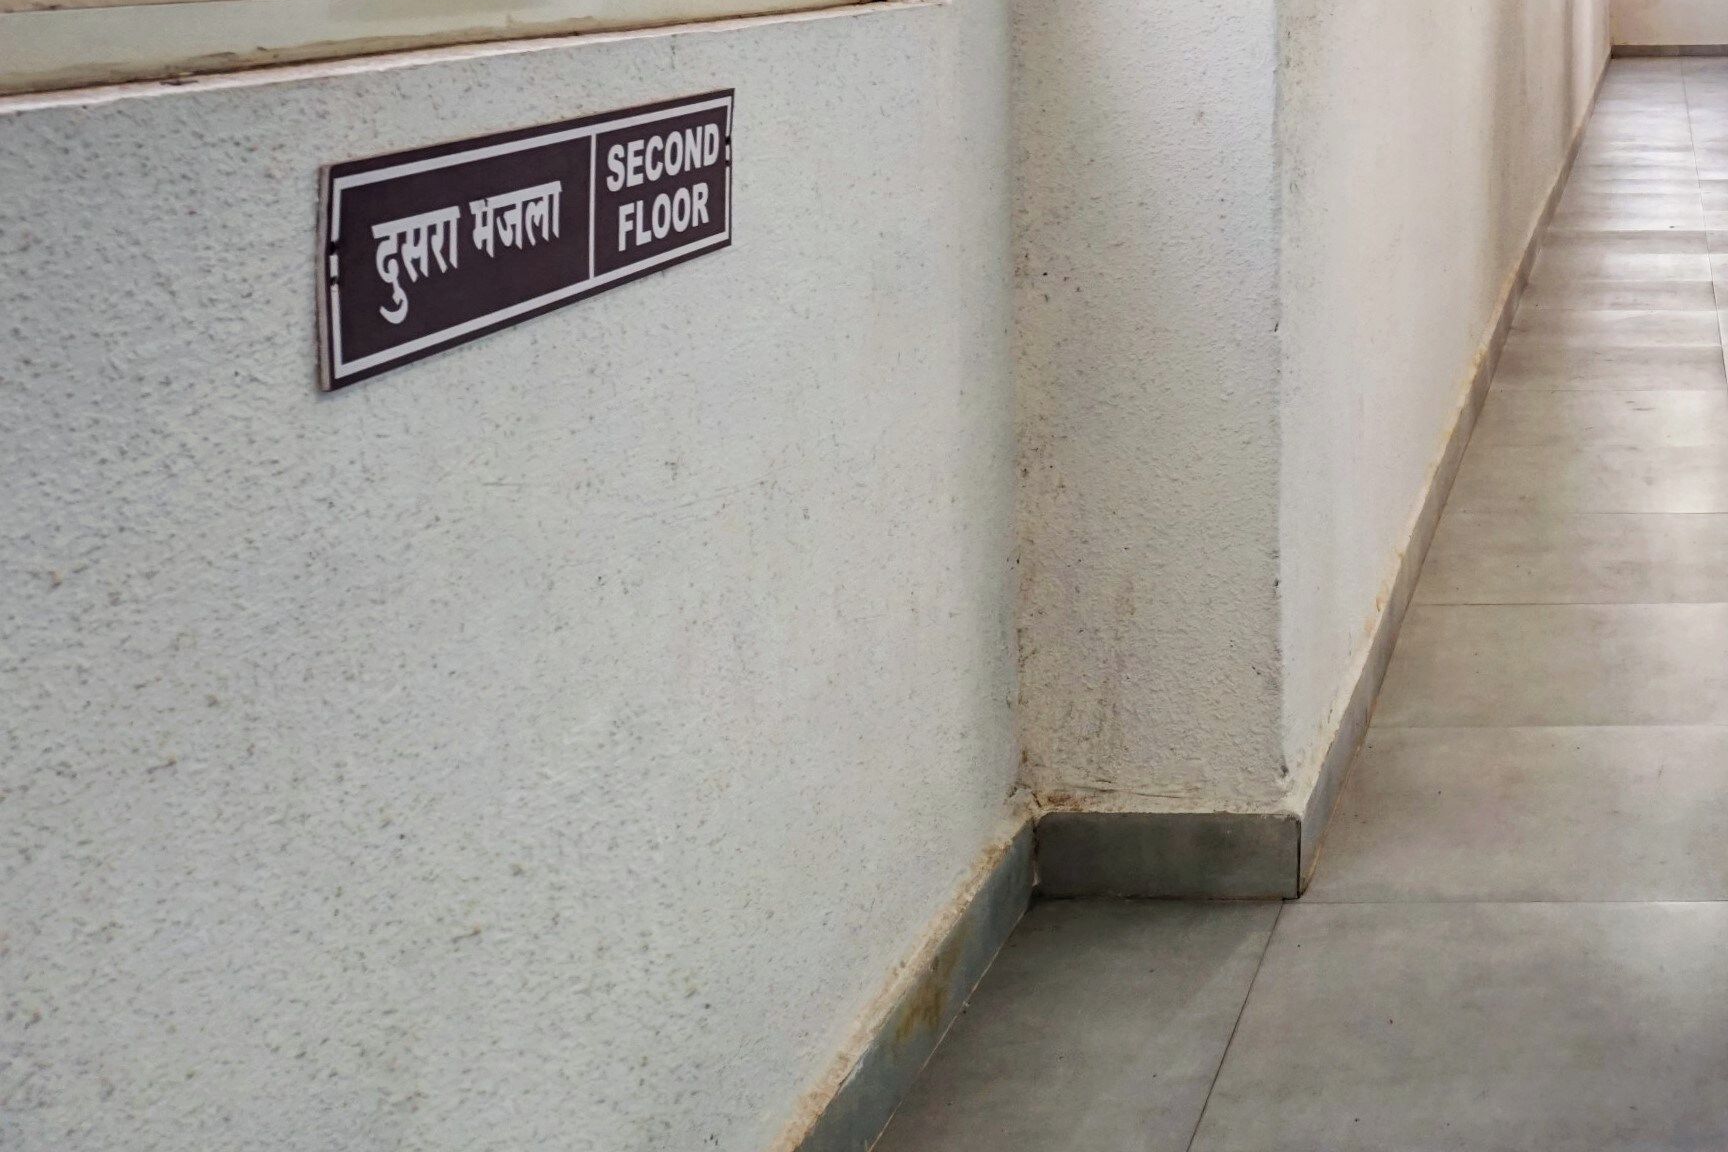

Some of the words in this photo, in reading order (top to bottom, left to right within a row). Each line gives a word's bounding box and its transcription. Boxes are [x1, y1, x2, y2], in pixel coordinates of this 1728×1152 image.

[606, 123, 720, 192] SECOND
[618, 182, 710, 252] FLOOR
[371, 205, 461, 324] दुसरा
